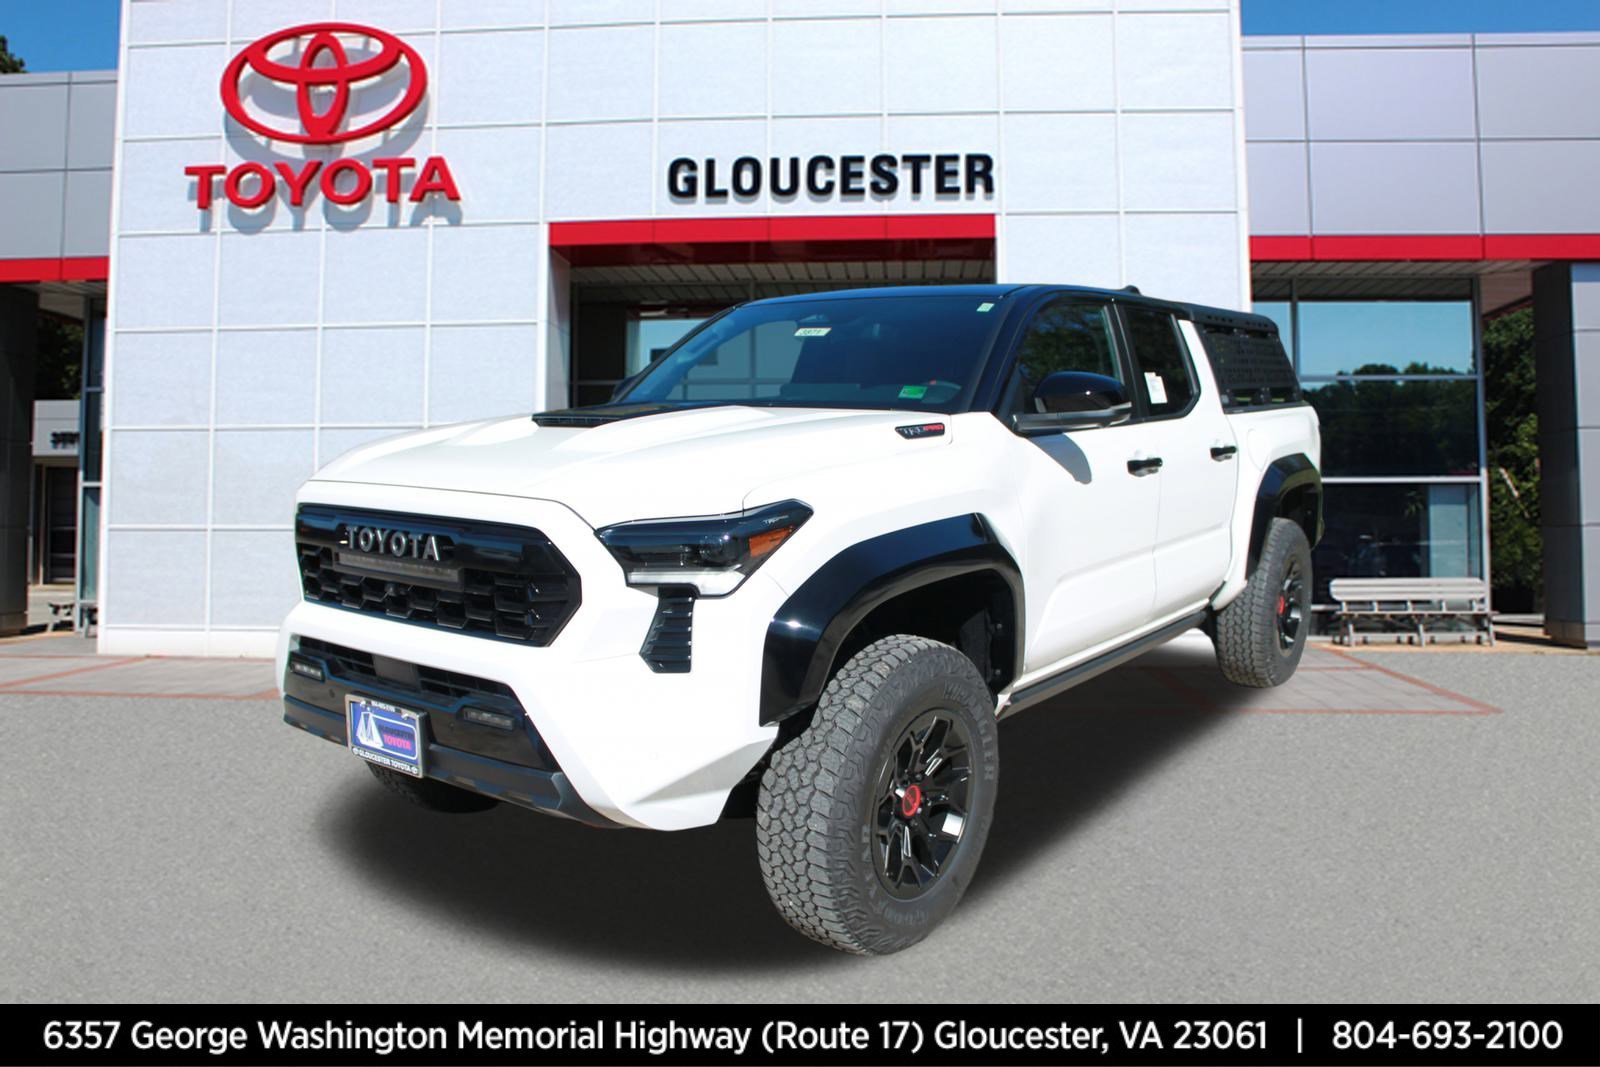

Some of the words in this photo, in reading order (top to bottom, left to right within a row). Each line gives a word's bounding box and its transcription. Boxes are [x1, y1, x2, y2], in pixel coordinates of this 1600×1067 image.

[185, 157, 461, 210] TOYOTA
[668, 154, 995, 198] GLOUCESTER
[346, 526, 439, 560] TOYOTA
[383, 733, 412, 750] TOYOTA
